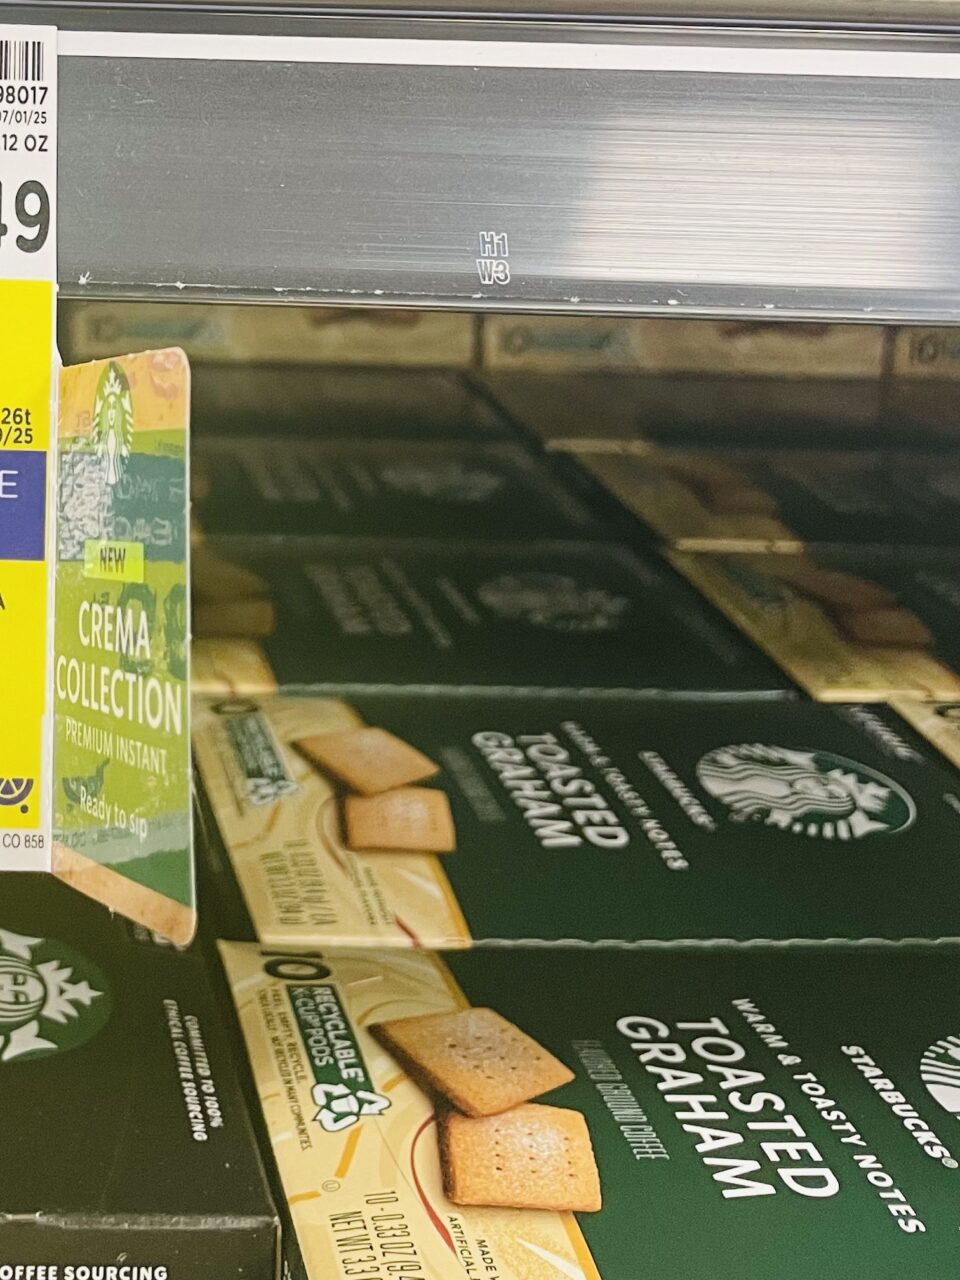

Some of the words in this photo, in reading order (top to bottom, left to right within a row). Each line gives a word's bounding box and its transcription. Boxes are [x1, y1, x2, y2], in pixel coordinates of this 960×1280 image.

[23, 134, 48, 152] OZ
[1, 407, 32, 426] 26t
[99, 547, 126, 574] NEW
[78, 600, 151, 658] CREMA
[56, 655, 182, 735] COLLECTION
[65, 718, 113, 758] PREMIUM
[116, 735, 167, 775] INSTANT
[471, 731, 583, 849] GRAHAM
[516, 732, 630, 849] TOASTED
[80, 786, 111, 828] Ready
[114, 804, 127, 829] to
[129, 814, 147, 842] sip
[24, 834, 45, 849] 858
[259, 950, 331, 980] 10
[181, 1081, 208, 1142] SOURCING
[595, 1083, 647, 1122] GROUND
[615, 1015, 777, 1199] GRAHAM
[676, 1017, 840, 1198] TOASTED
[732, 998, 789, 1048] WARM
[793, 1071, 867, 1148] TOASTY
[853, 1154, 927, 1234] NOTES
[620, 1125, 670, 1160] COFFEE
[364, 1191, 399, 1205] 10
[329, 1210, 367, 1233] NET
[336, 1233, 374, 1254] WT
[447, 1215, 477, 1275] ARTIFICIAL
[475, 1238, 497, 1271] MADE
[63, 1265, 168, 1280] SOURCING
